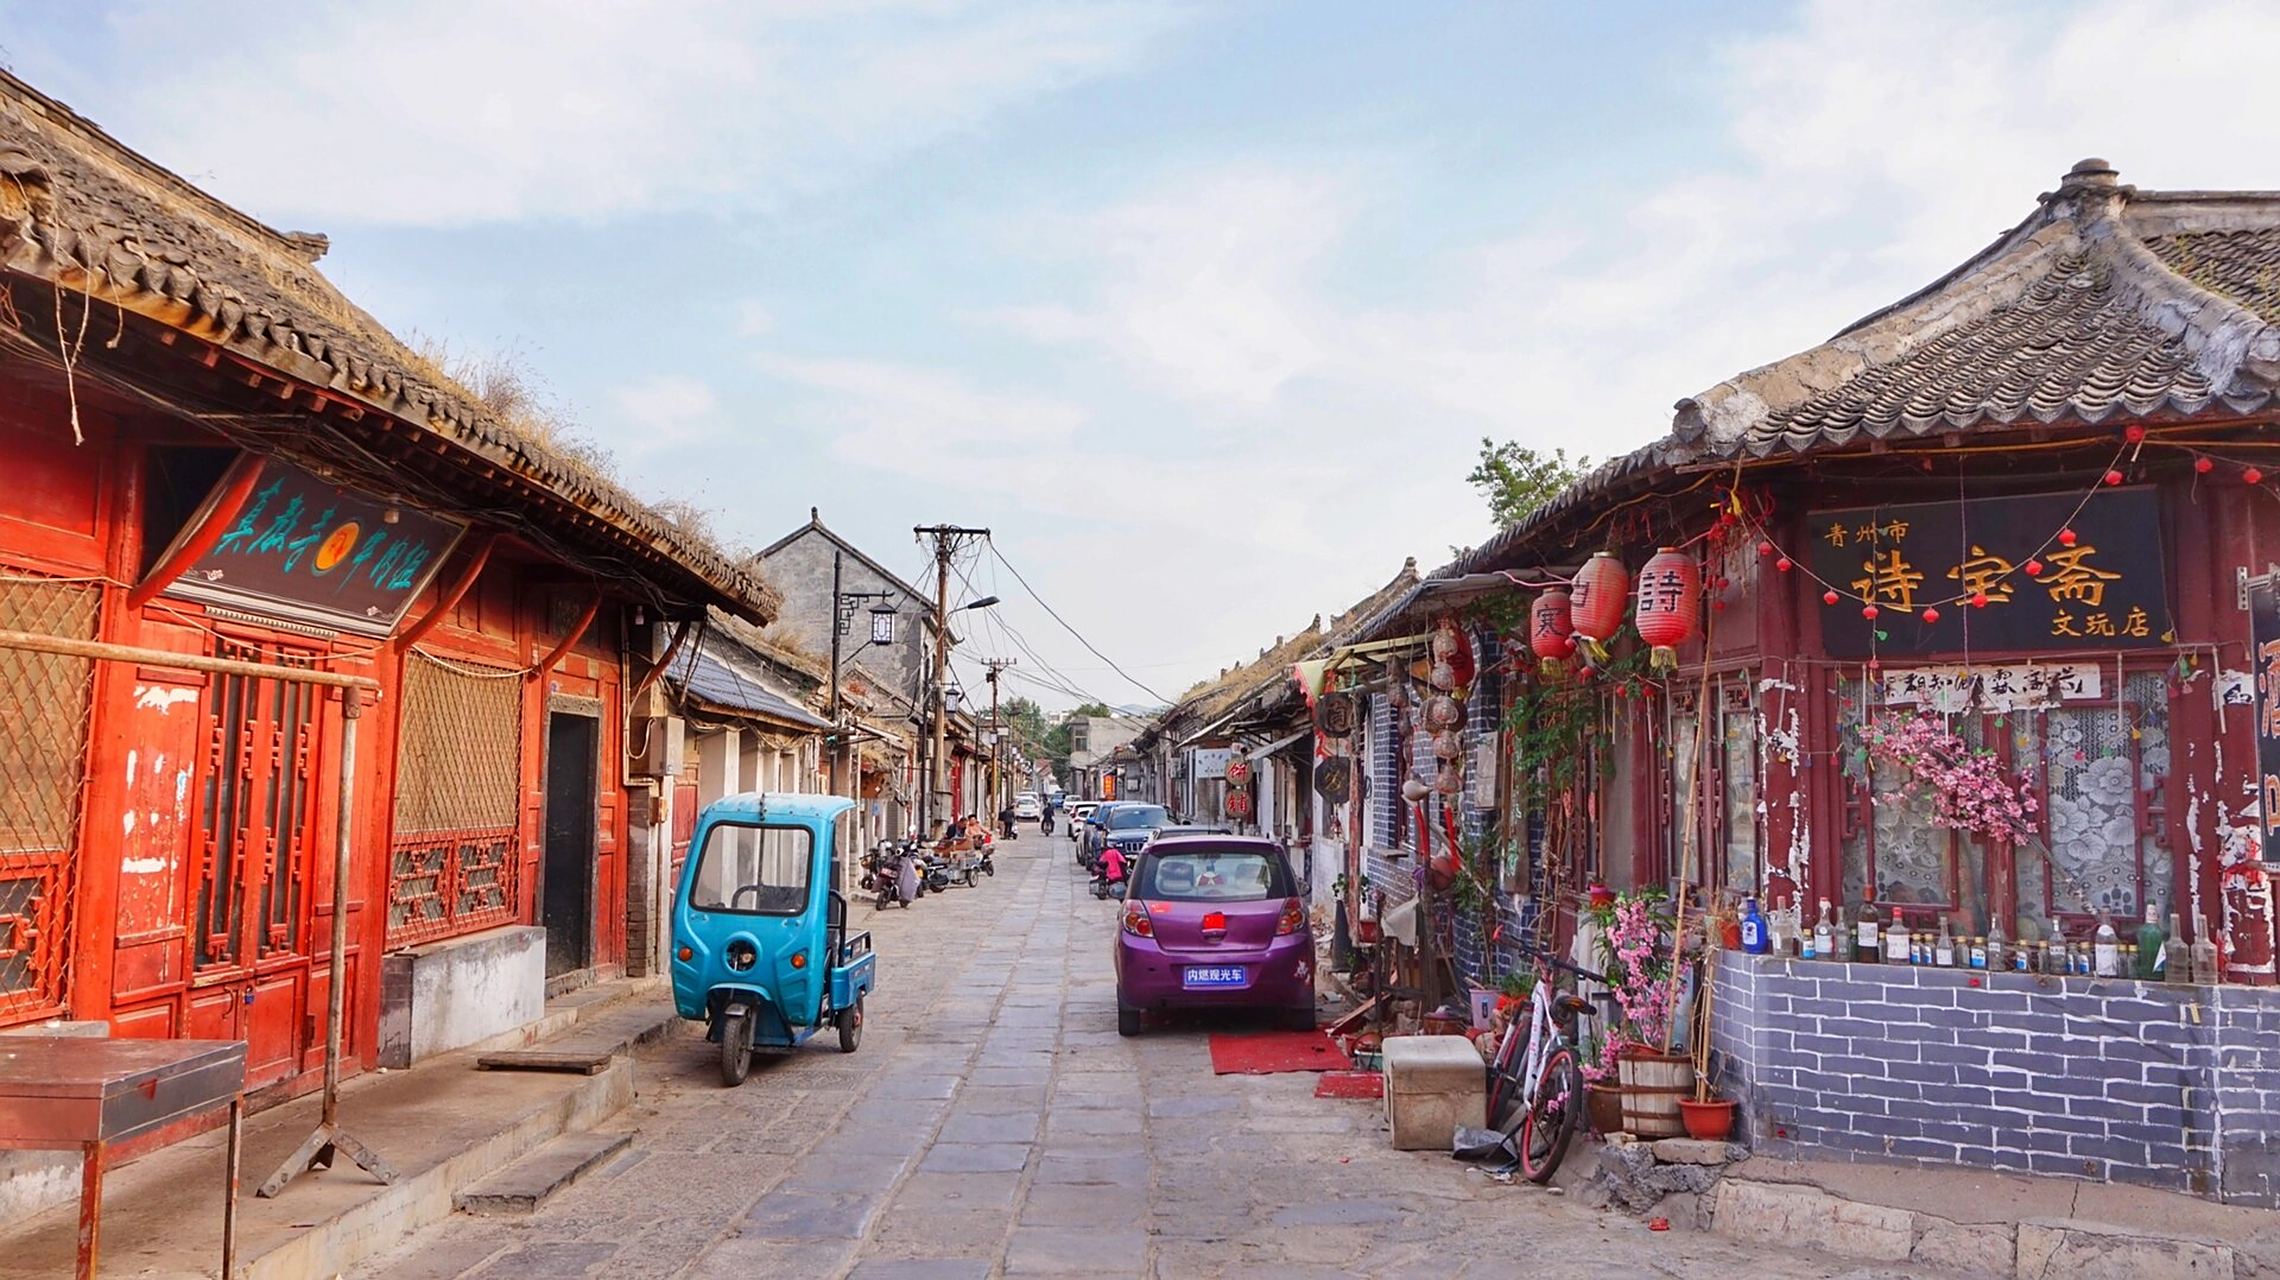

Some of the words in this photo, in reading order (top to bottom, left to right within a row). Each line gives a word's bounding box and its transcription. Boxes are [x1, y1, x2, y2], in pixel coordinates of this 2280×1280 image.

[1823, 519, 1910, 548] 青州市
[1850, 544, 2122, 613] 诗宝斋
[2050, 605, 2150, 639] 文玩店
[1187, 968, 1242, 982] 内燃观光车
